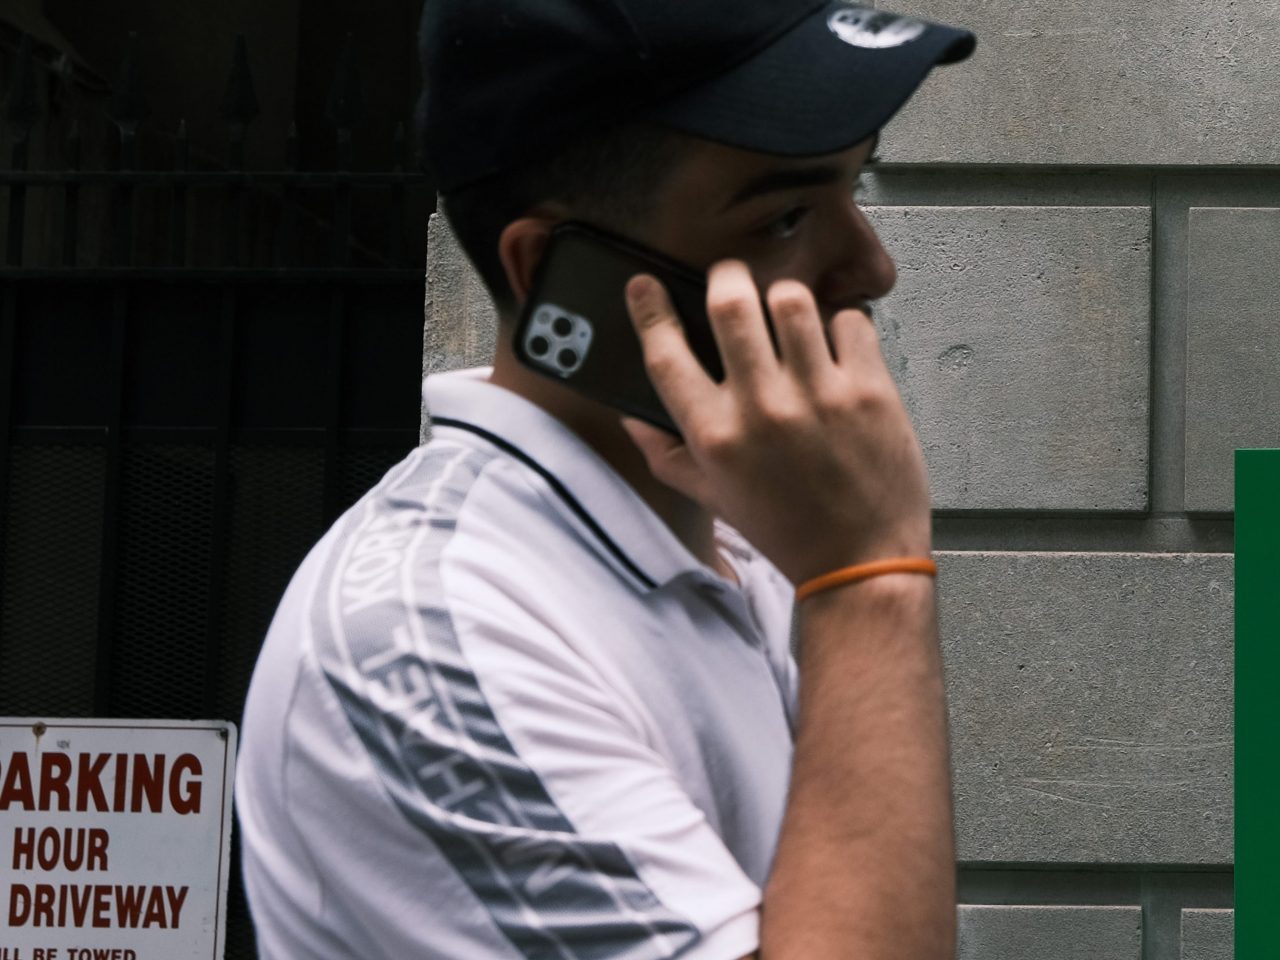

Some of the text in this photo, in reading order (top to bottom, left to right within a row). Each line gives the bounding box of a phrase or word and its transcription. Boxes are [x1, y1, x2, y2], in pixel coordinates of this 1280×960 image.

[0, 751, 203, 815] ARKING
[12, 826, 109, 871] HOUR
[8, 883, 189, 929] DRIVEWAY
[33, 948, 58, 960] BE
[67, 948, 137, 960] TOWED
